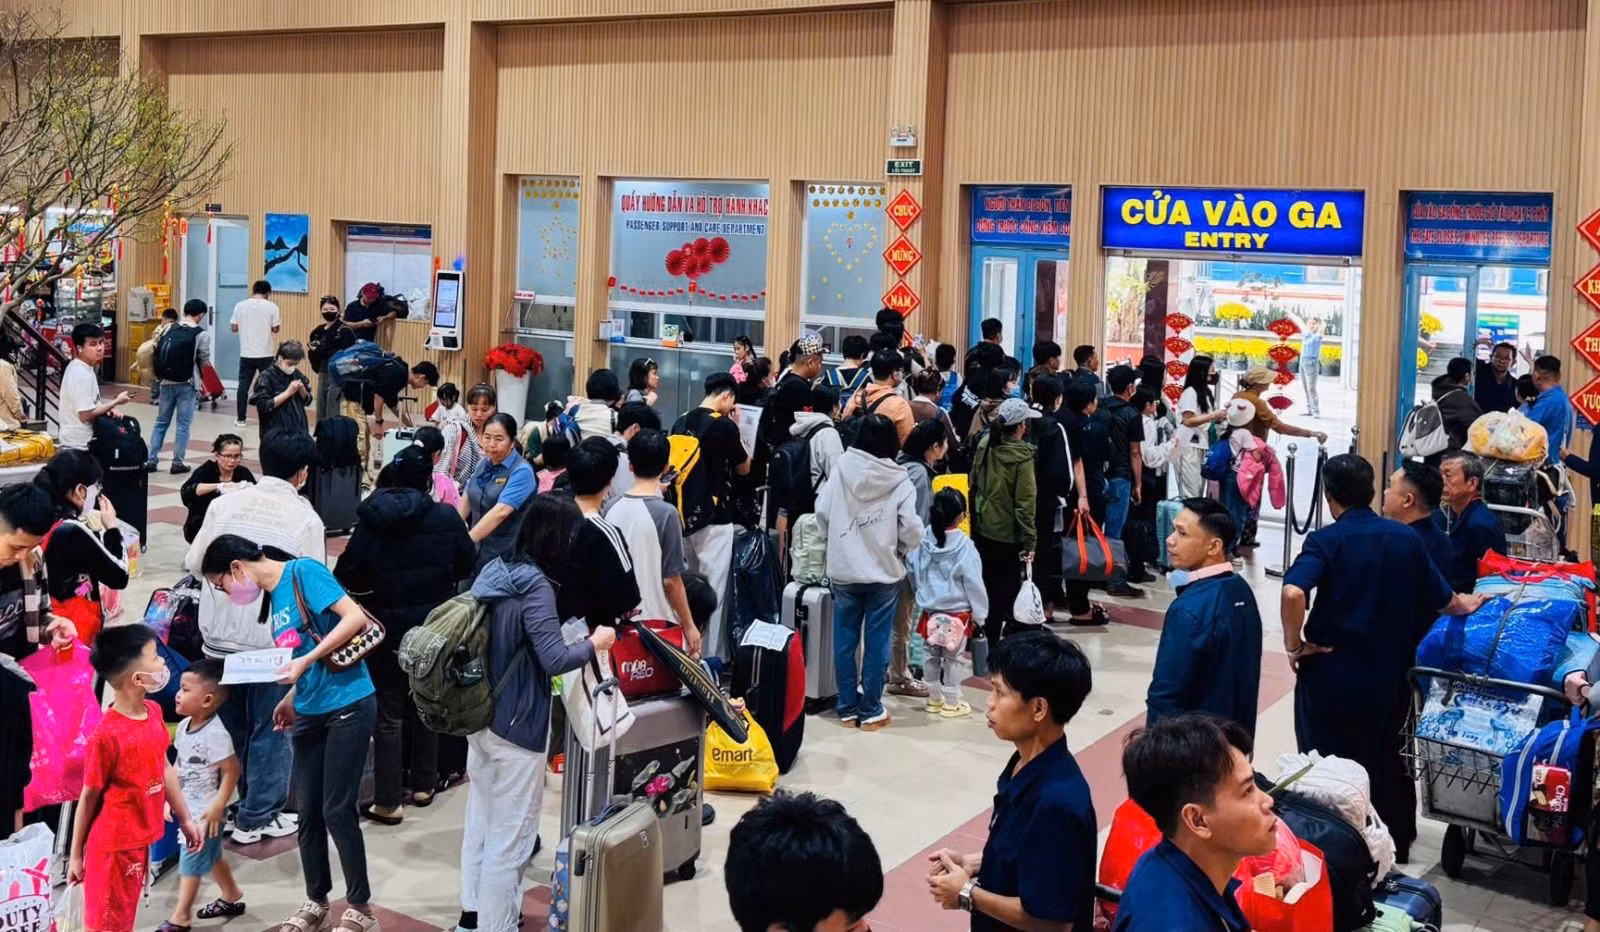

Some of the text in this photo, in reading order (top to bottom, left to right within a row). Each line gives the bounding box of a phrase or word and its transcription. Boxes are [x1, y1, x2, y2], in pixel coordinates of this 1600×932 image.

[894, 201, 914, 217] CHÚC
[1120, 189, 1343, 229] CỬA VÀO GA
[626, 219, 765, 235] PASSENGER SUPPORT AND CARE DEPARTMENT
[1184, 231, 1270, 249] ENTRY
[712, 747, 753, 762] emart
